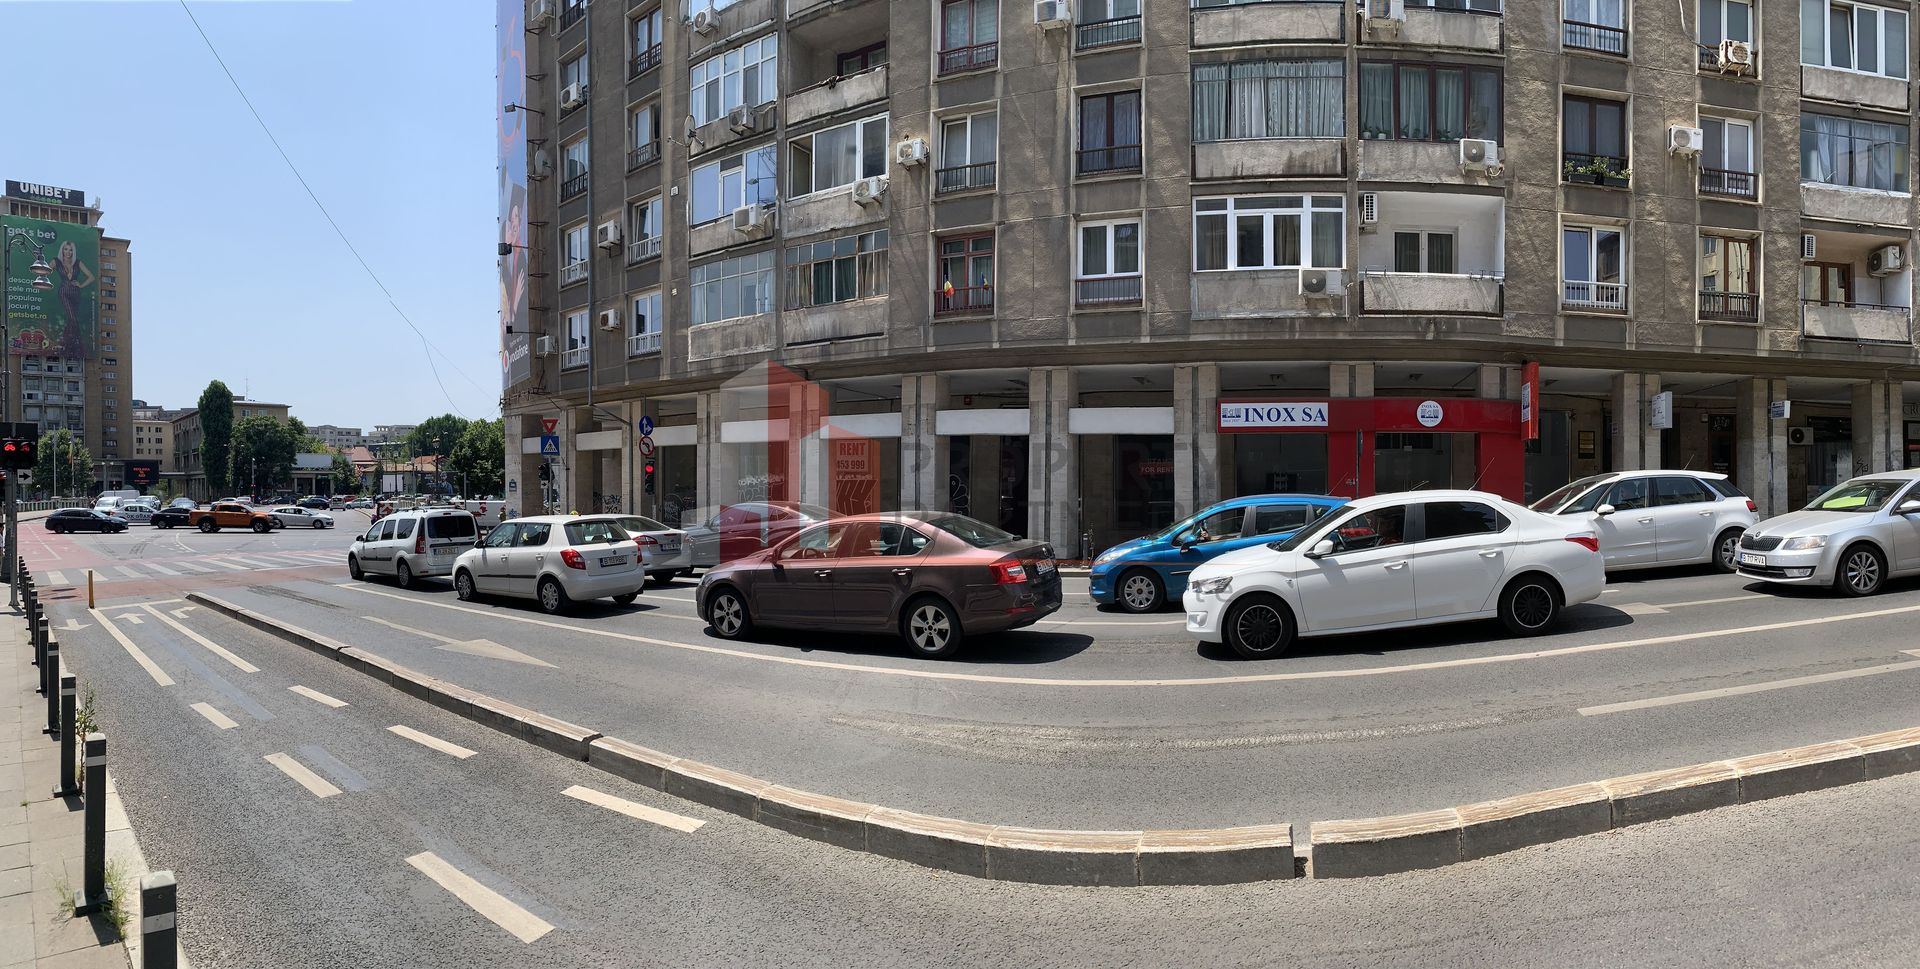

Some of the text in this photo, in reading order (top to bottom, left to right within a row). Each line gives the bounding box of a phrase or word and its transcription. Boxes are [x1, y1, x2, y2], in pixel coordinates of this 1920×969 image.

[20, 182, 71, 199] UNIBET
[37, 229, 55, 239] bet
[8, 295, 42, 303] populare
[8, 302, 30, 310] jocuri
[8, 312, 47, 320] getsbet.ro
[1244, 407, 1327, 423] INOX SA
[840, 442, 865, 456] RENT
[850, 460, 865, 469] 999
